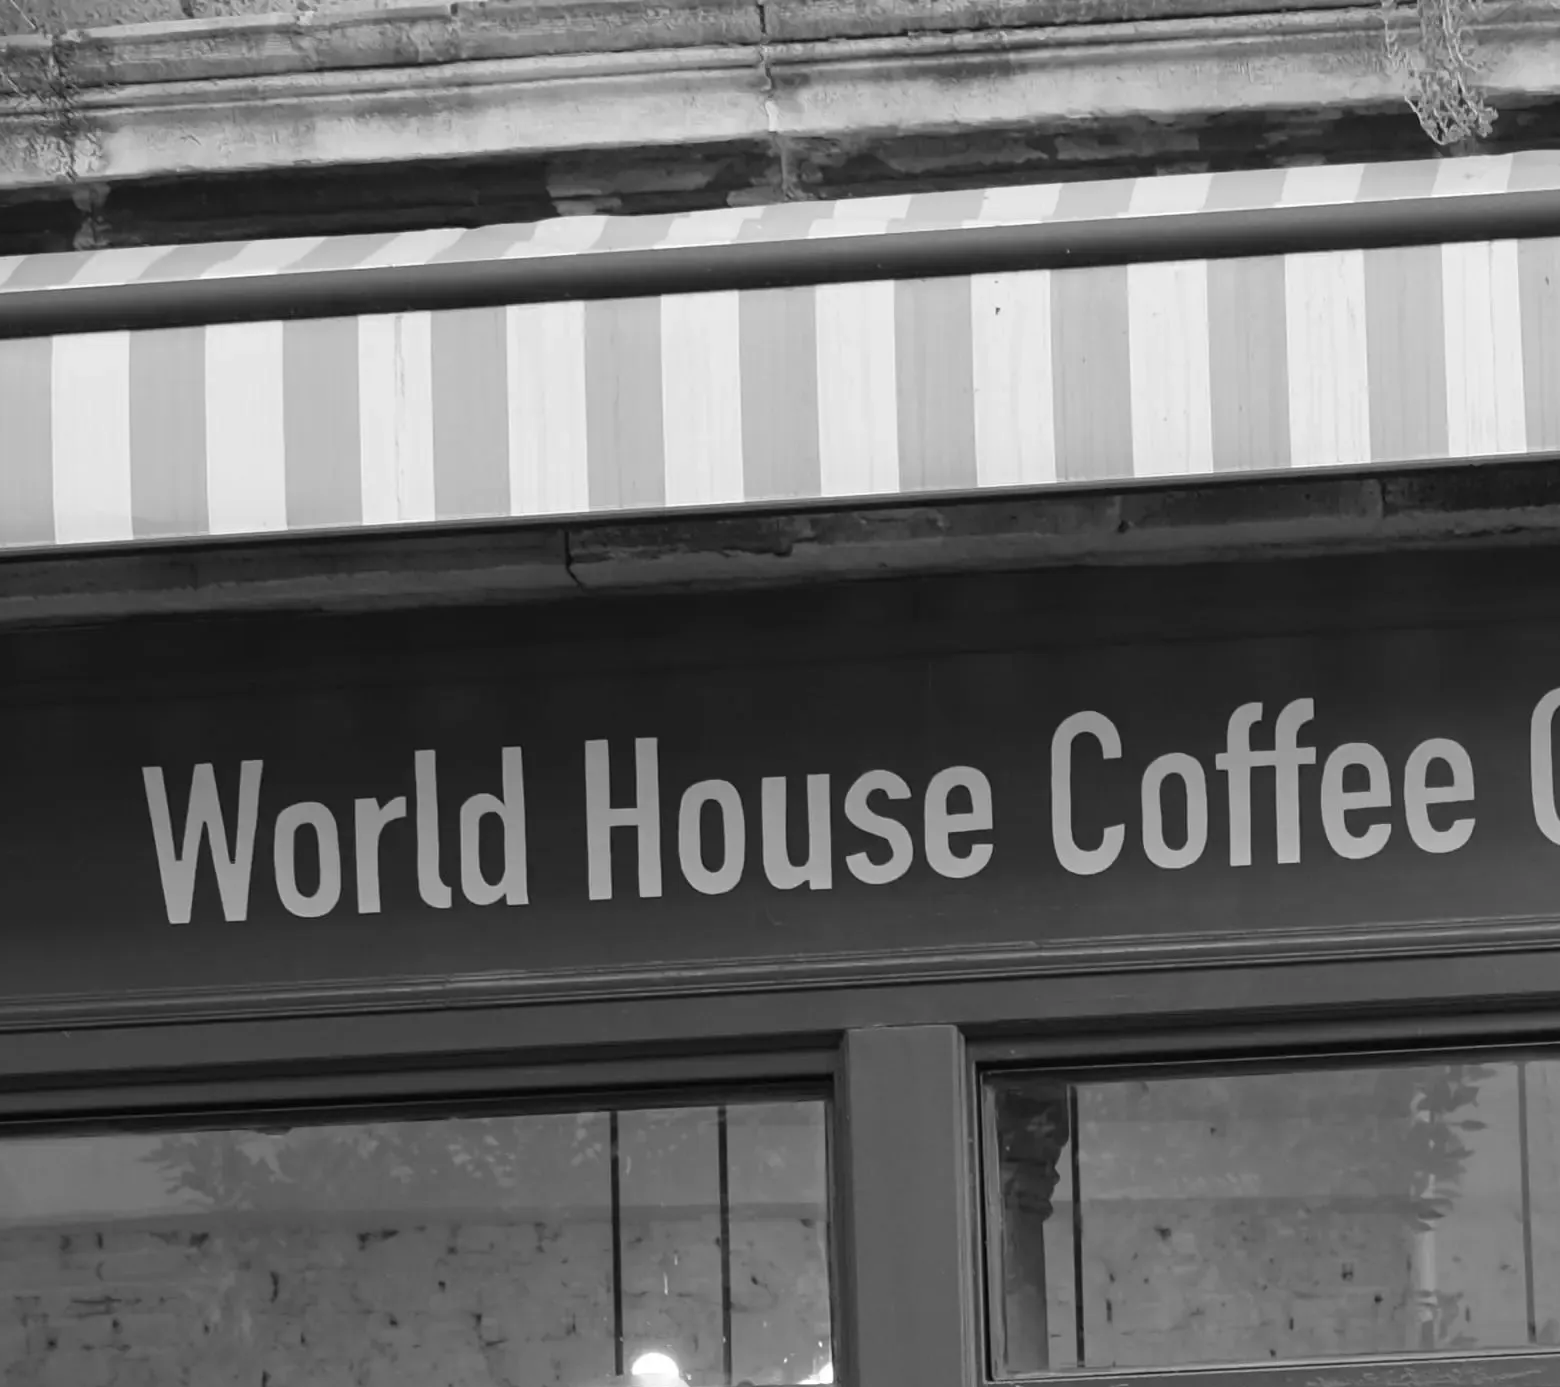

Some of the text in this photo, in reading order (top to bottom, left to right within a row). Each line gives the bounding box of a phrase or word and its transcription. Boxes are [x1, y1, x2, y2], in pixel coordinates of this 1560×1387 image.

[143, 747, 529, 925] World
[585, 737, 994, 901] House
[1051, 697, 1476, 876] Coffee
